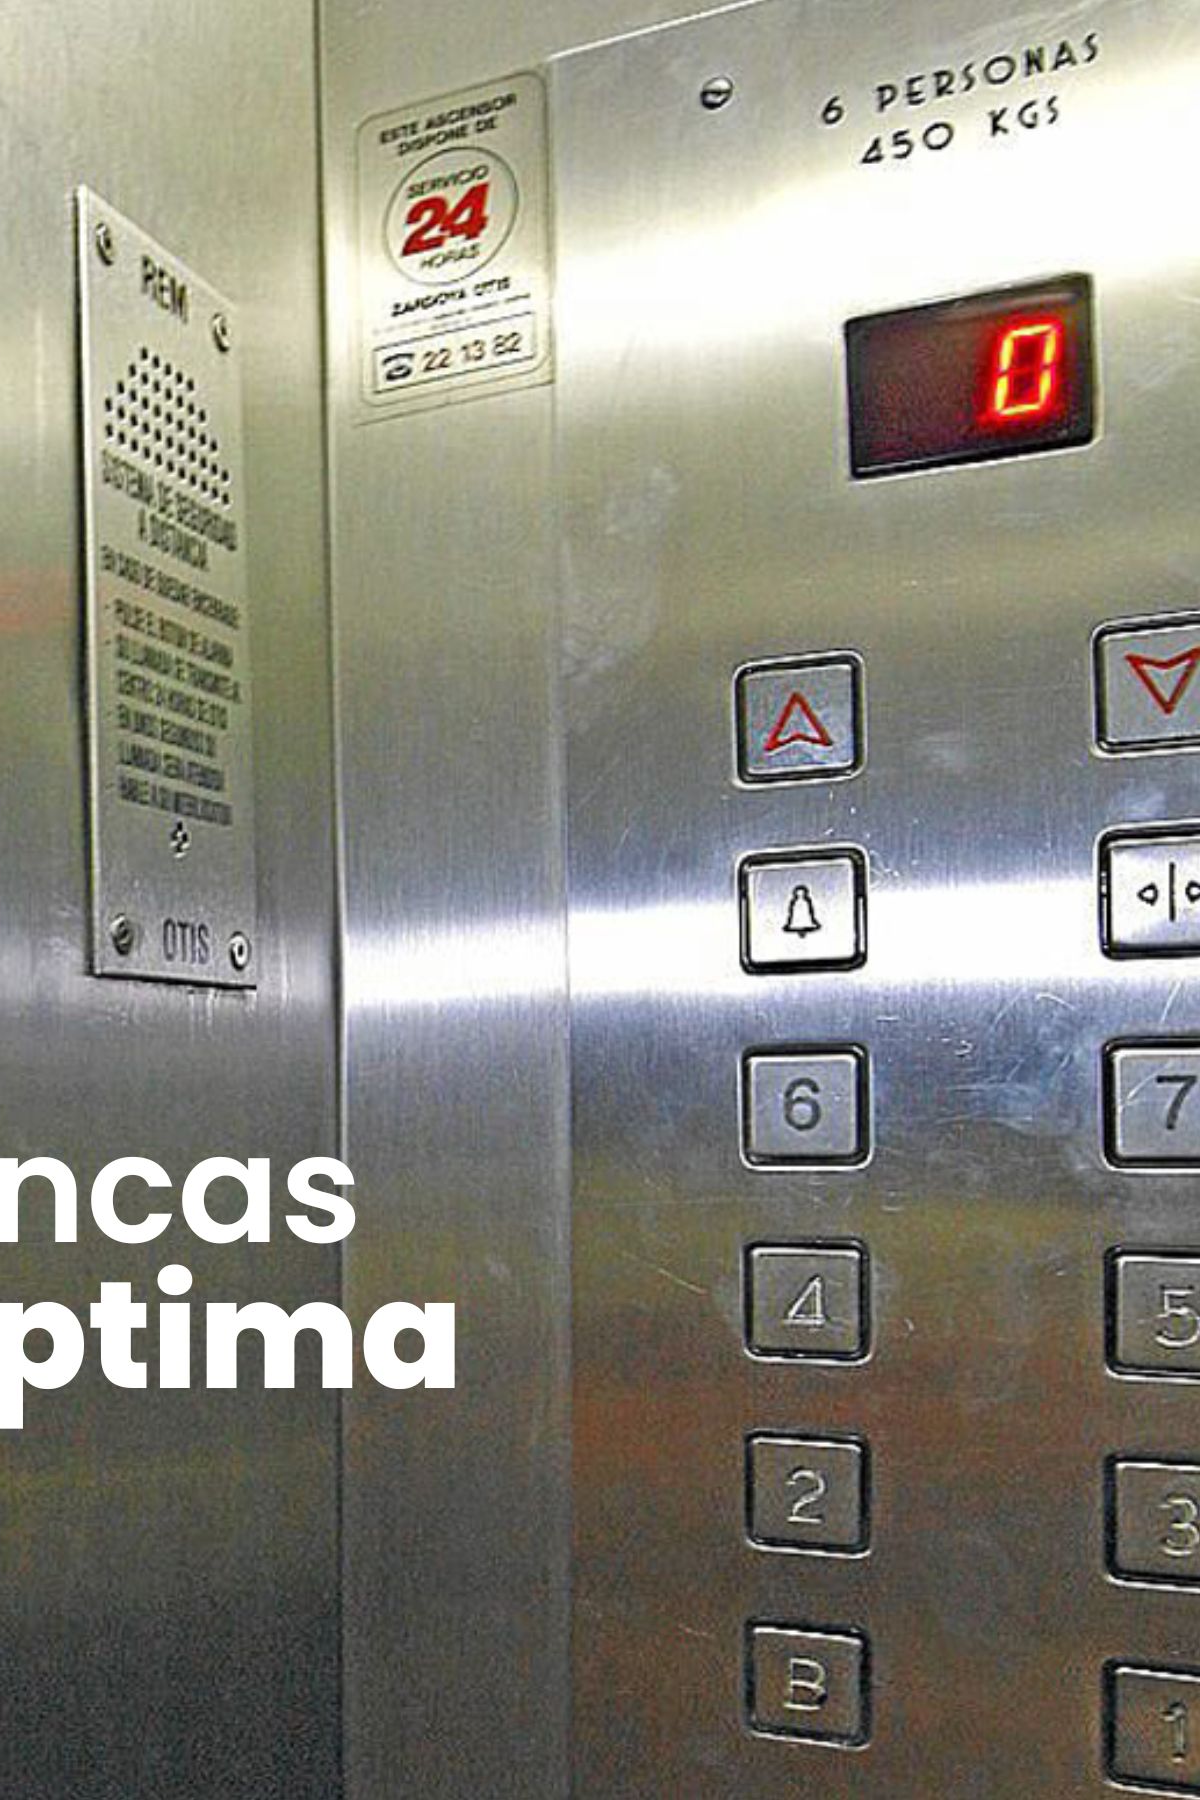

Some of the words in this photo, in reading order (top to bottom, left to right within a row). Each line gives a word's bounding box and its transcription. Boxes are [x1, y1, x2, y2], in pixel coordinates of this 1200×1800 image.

[821, 96, 844, 126] 6
[875, 33, 1100, 113] PERSONAS
[380, 121, 419, 145] ESTE
[424, 93, 518, 130] ASCENSOR
[398, 124, 469, 157] DISPONE
[475, 115, 499, 134] DE
[859, 121, 955, 165] 450
[986, 95, 1060, 137] KGS
[408, 164, 490, 199] SERVICIO
[401, 182, 491, 256] 24
[420, 242, 481, 270] HORAS
[422, 346, 452, 373] 22
[460, 338, 486, 362] 13
[993, 321, 1059, 416] 0
[162, 916, 211, 965] OTIS
[783, 1077, 822, 1132] 6
[1154, 1073, 1198, 1131] 7
[783, 1273, 827, 1326] 4
[1154, 1283, 1200, 1349] 5
[784, 1468, 827, 1525] 2
[1158, 1492, 1200, 1558] 3
[783, 1656, 829, 1712] B
[1159, 1699, 1188, 1764] 1
